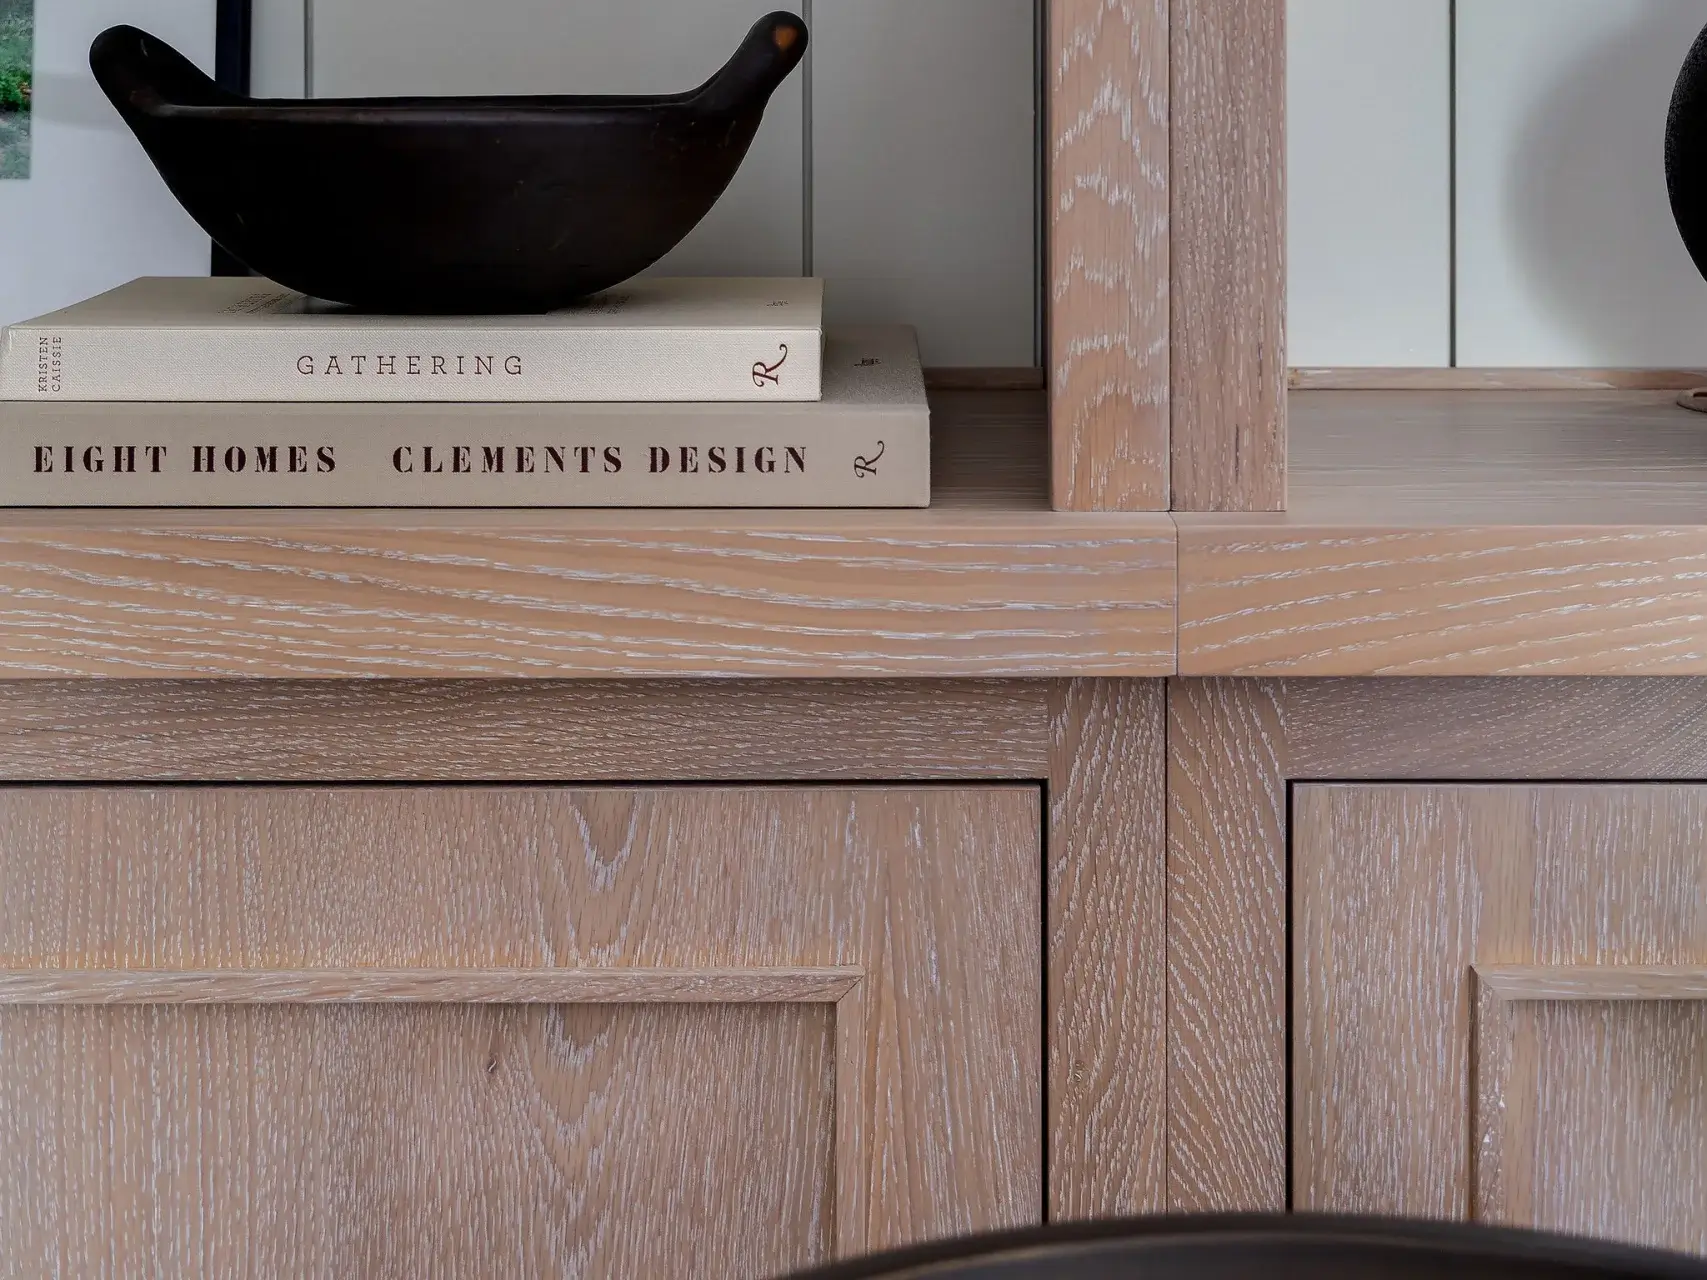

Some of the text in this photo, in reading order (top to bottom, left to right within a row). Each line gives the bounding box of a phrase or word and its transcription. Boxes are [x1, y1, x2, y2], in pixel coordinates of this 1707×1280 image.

[38, 336, 48, 393] KRISTEN
[52, 336, 62, 392] CAISSIE
[296, 355, 523, 376] GATHERING
[33, 445, 807, 474] EIGHT HOMES CLEMENTS DESIGN
